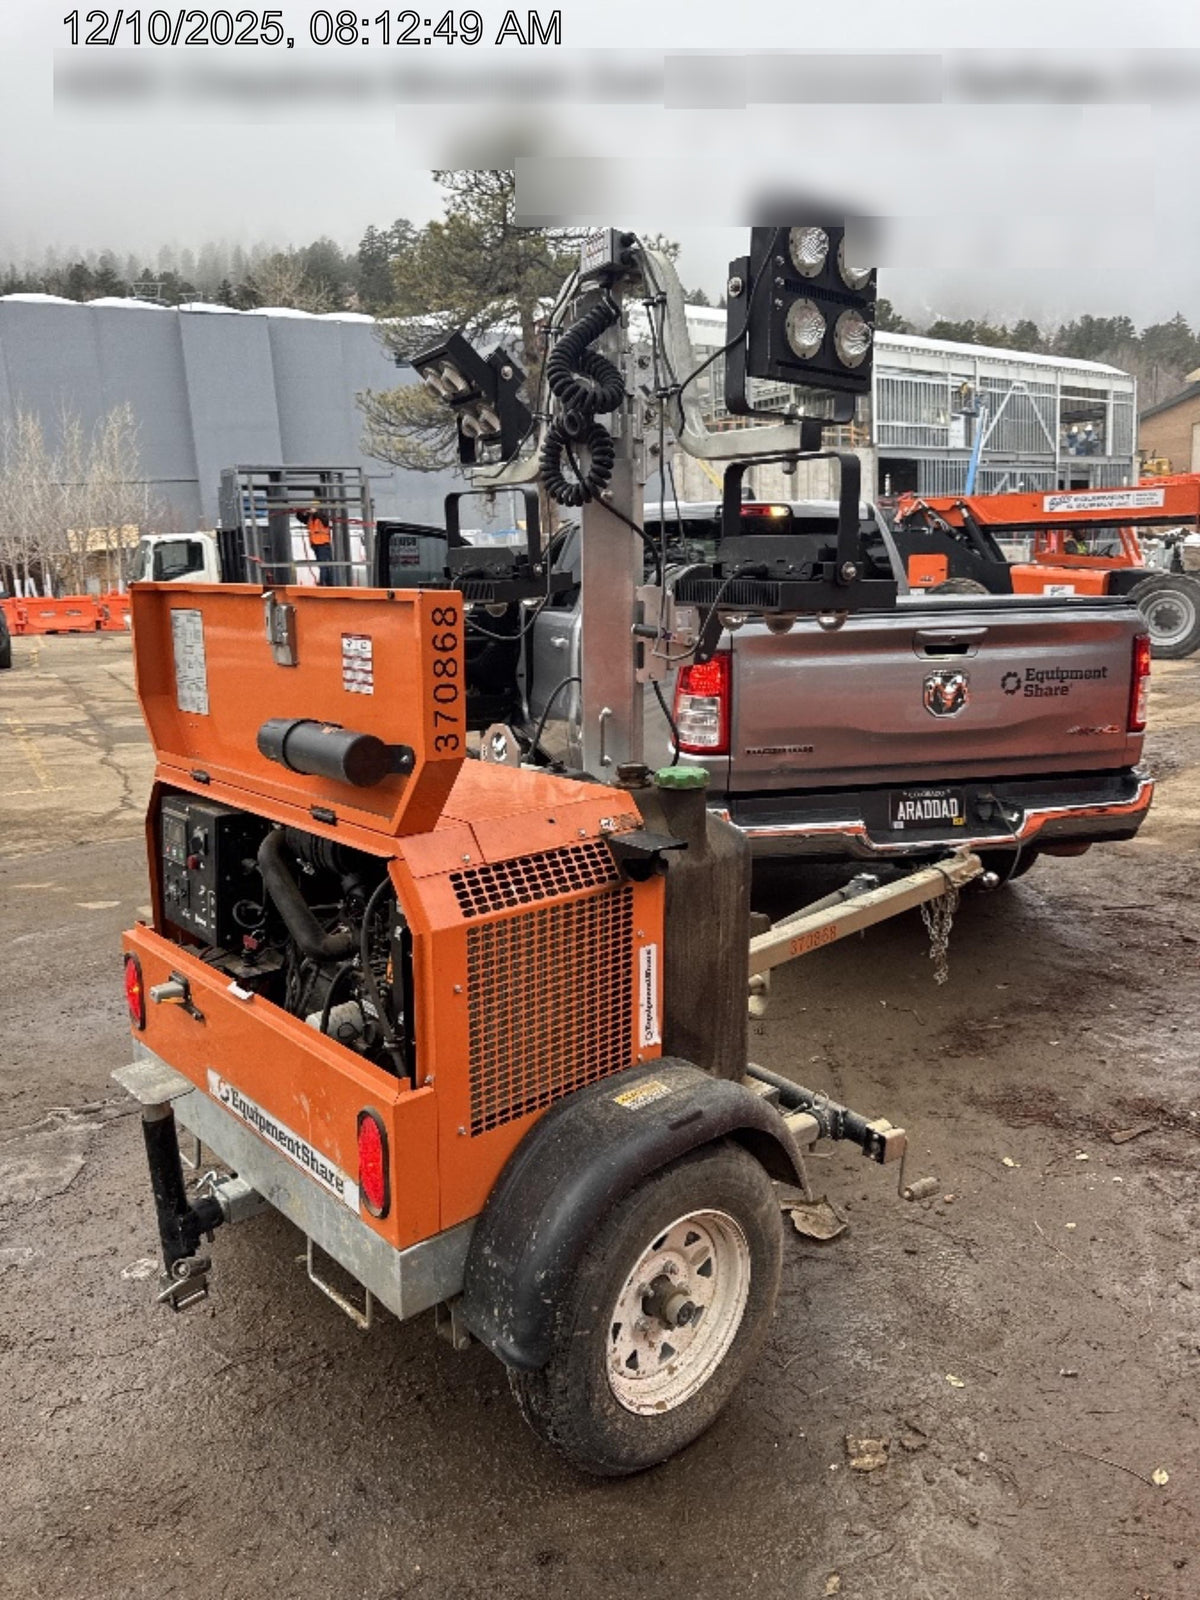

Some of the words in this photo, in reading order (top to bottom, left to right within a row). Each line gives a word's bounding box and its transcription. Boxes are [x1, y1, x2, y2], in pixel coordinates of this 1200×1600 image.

[431, 606, 460, 752] 370868
[1024, 666, 1108, 683] Equipment
[1023, 683, 1070, 697] Share
[897, 798, 959, 820] ARADDAD
[230, 1086, 345, 1195] EquipmentShare
